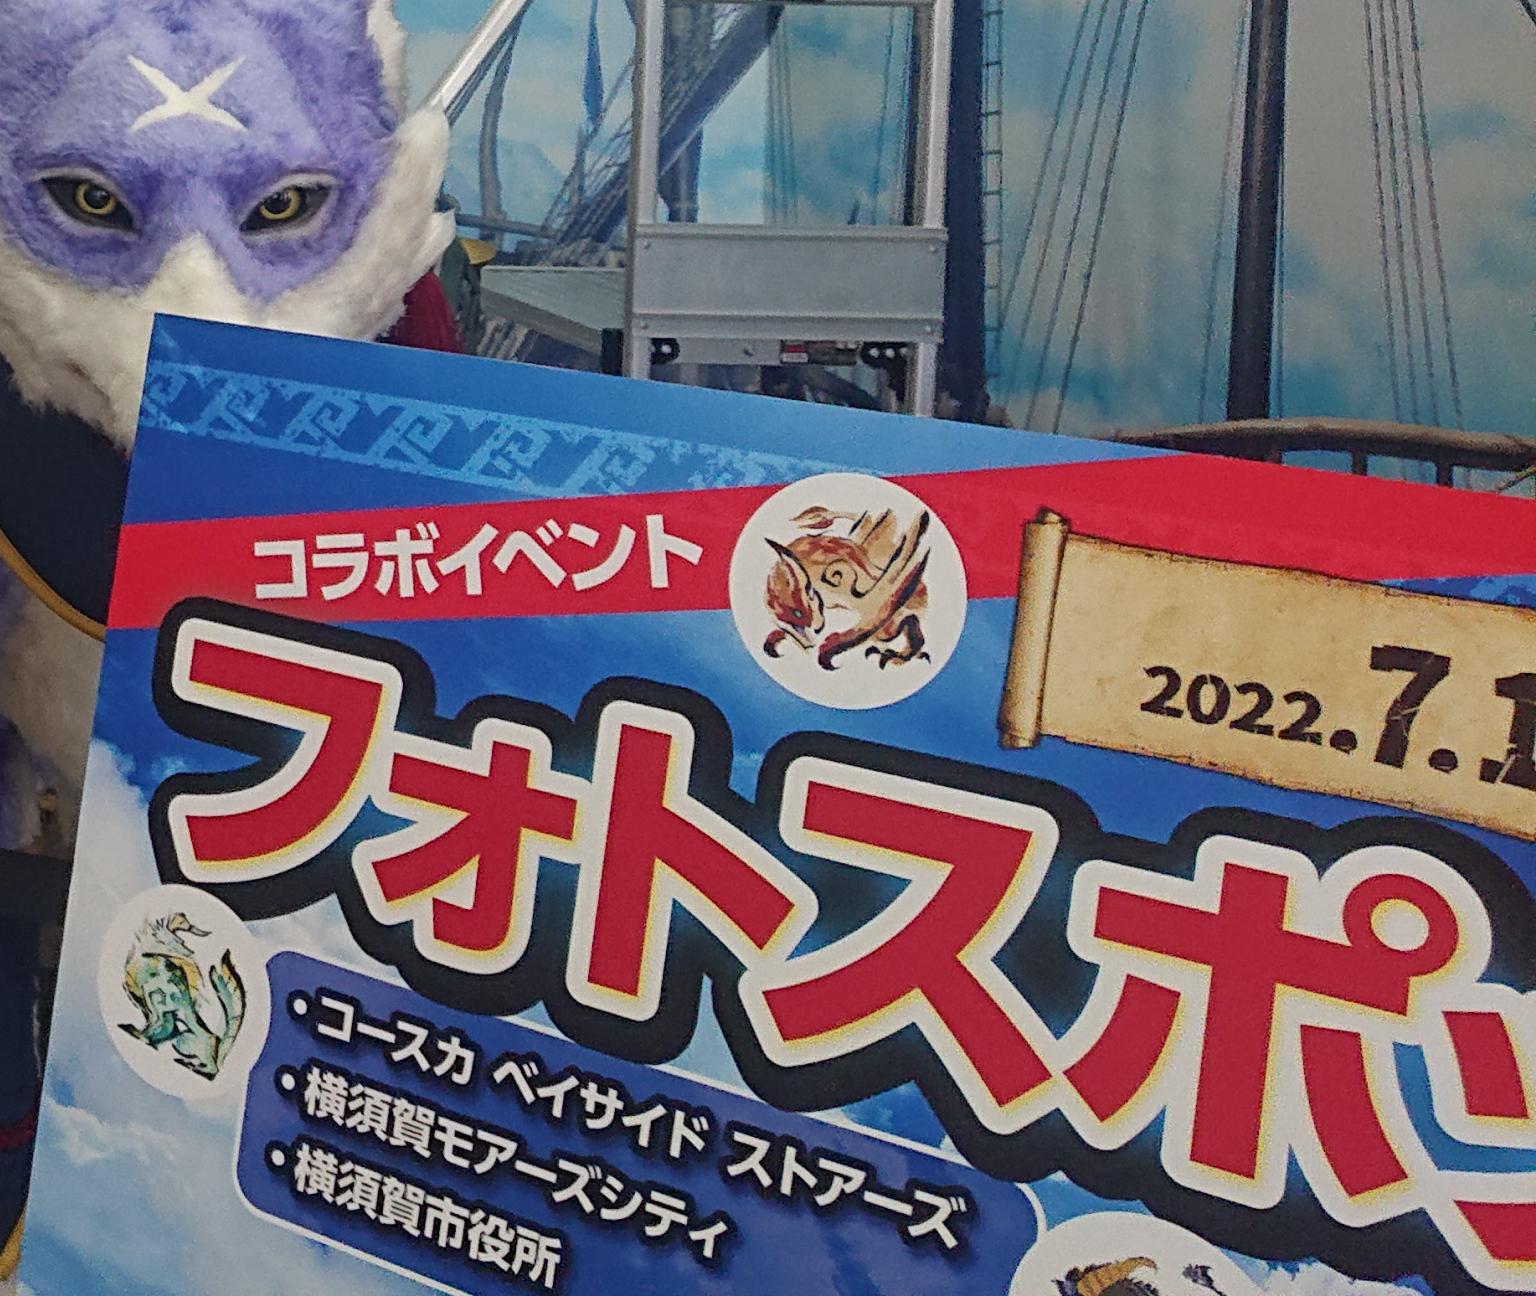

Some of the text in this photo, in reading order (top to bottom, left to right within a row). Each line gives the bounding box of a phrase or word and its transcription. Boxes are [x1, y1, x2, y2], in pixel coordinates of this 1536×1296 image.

[252, 513, 705, 606] コラボイベント
[492, 1057, 710, 1161] ベイサイド
[727, 1130, 969, 1252] ストアーズ
